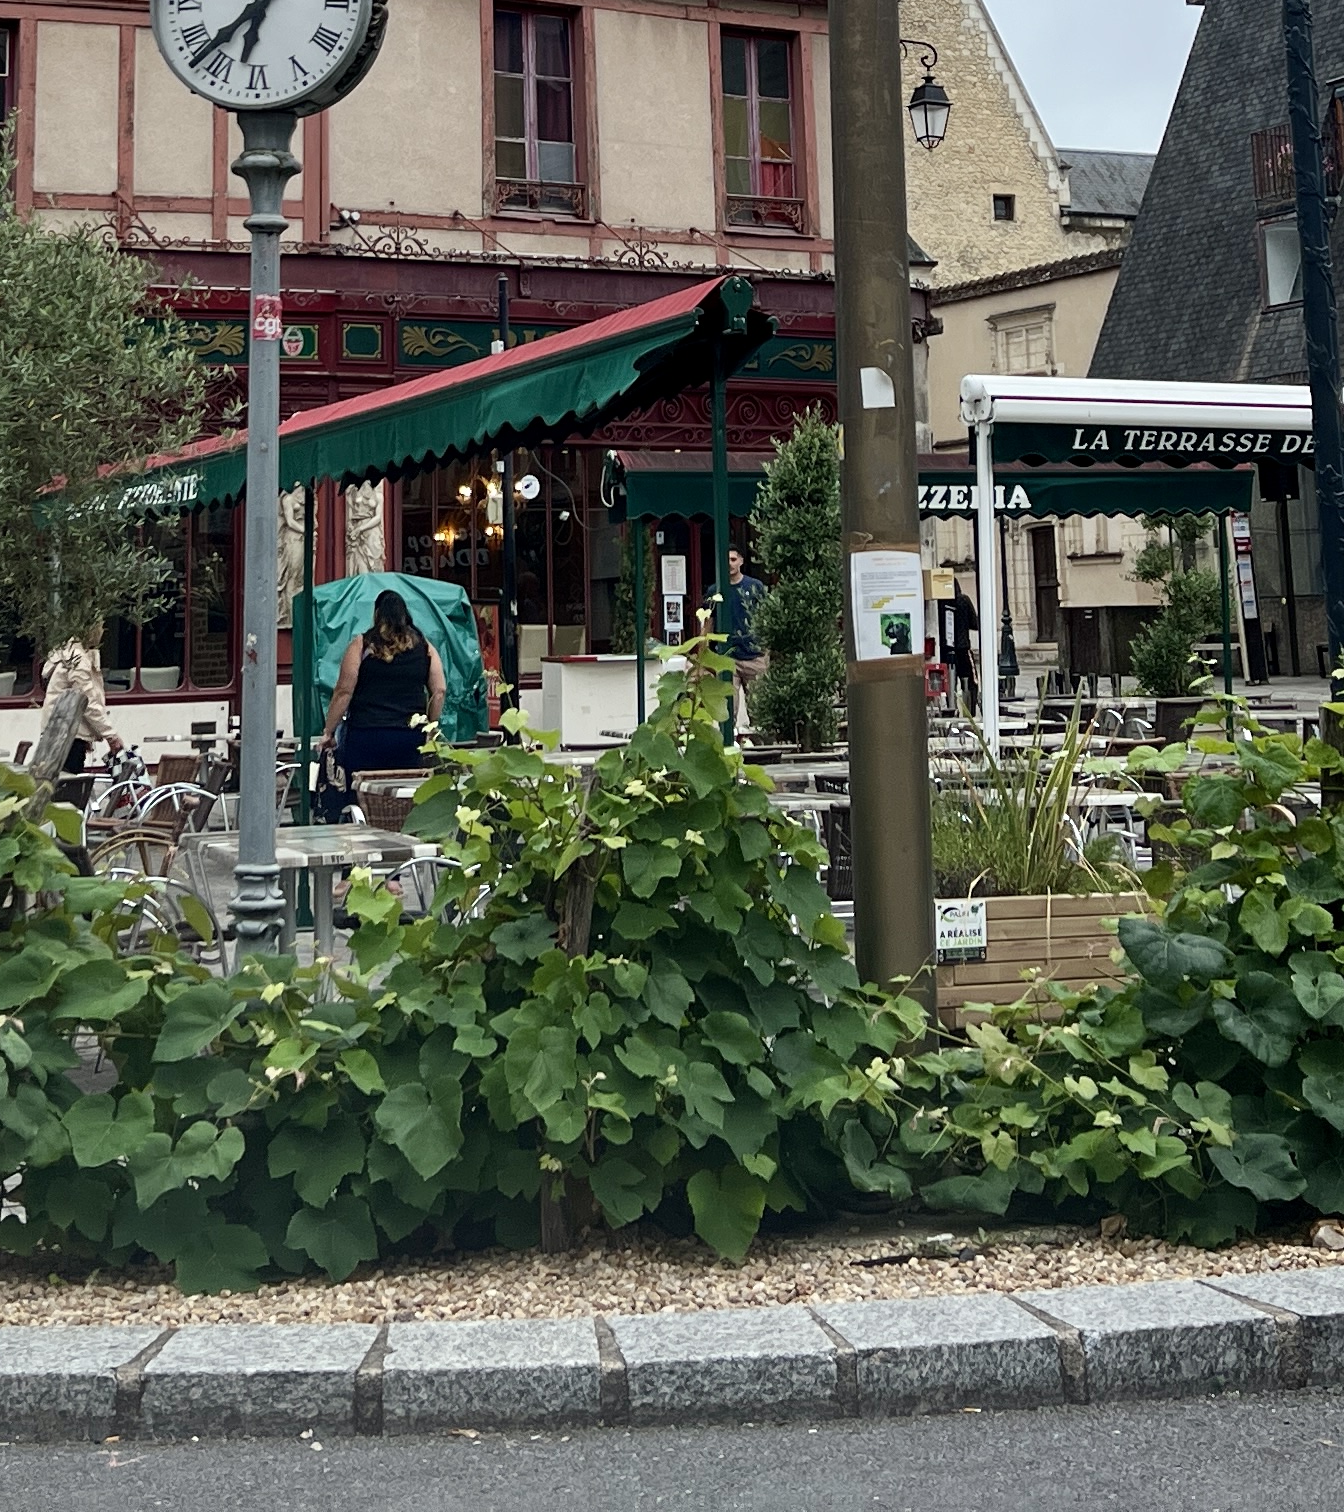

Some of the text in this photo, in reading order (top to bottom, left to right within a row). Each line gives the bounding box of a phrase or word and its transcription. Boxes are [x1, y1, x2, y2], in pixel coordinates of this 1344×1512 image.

[1071, 428, 1110, 451] LA
[1123, 429, 1272, 453] TERRASSE
[940, 931, 946, 939] A
[953, 938, 983, 946] JARDIN
